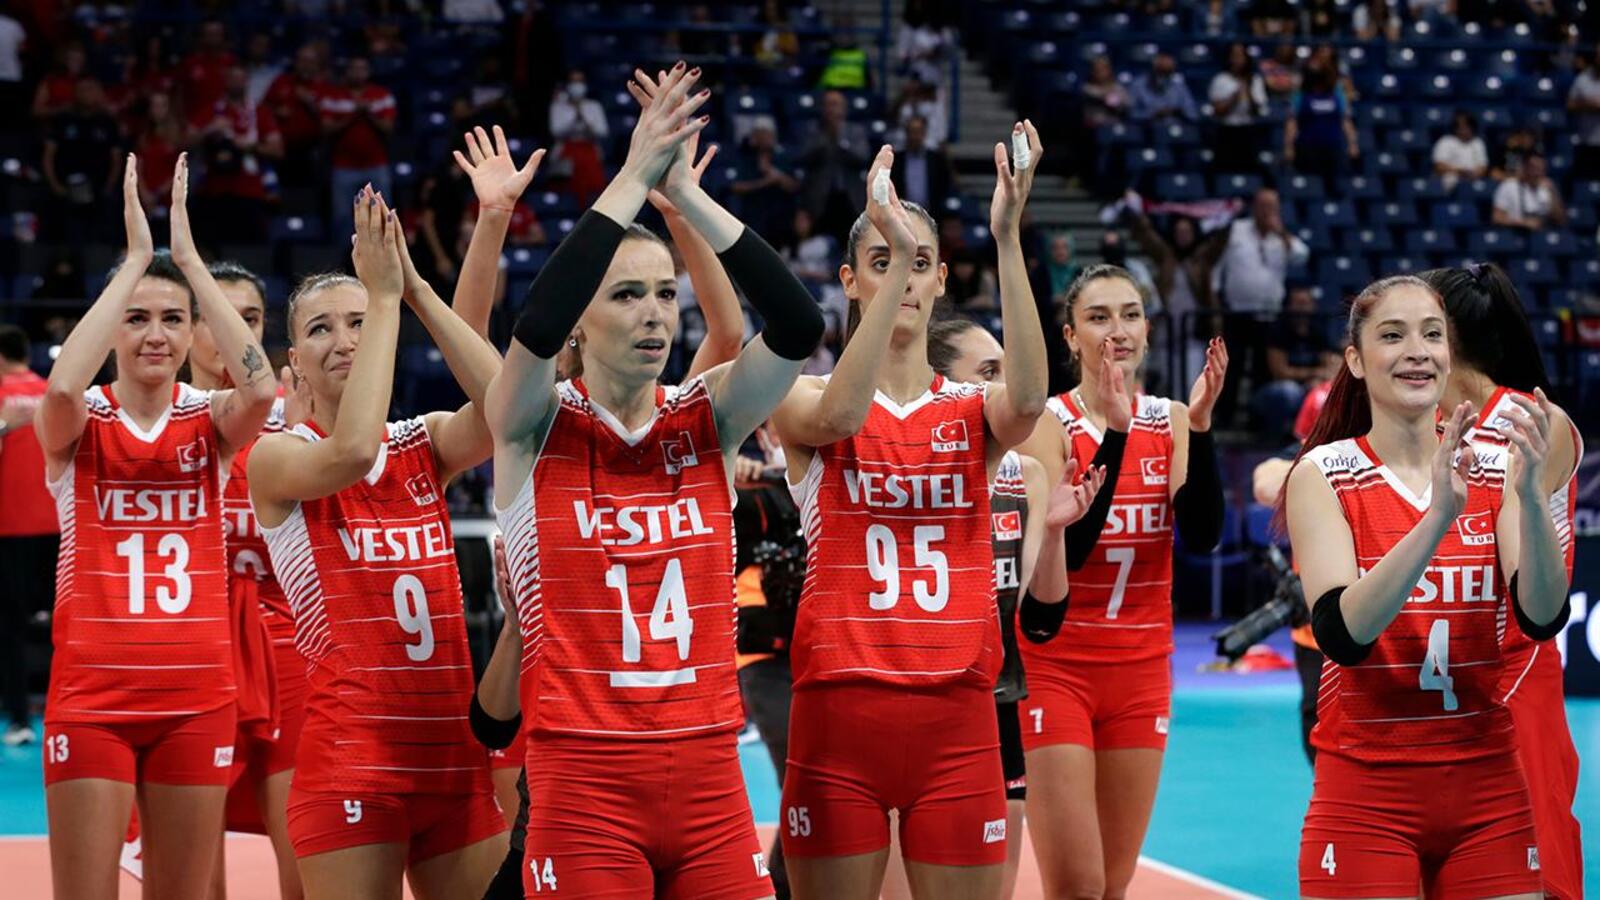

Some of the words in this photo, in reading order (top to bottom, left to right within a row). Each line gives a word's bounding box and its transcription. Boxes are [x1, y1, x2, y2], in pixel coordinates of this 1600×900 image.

[939, 441, 962, 451] TUR
[93, 485, 208, 522] VESTEL
[843, 468, 973, 510] VESTEL
[573, 497, 715, 547] VESTEL
[1101, 502, 1172, 537] STEL
[1470, 534, 1494, 544] TUR
[338, 520, 455, 562] VESTEL
[116, 532, 192, 615] 13
[865, 523, 950, 613] 95
[1105, 546, 1136, 620] 7
[1359, 565, 1497, 604] STEL
[392, 573, 435, 663] 9
[605, 557, 694, 663] 14
[1418, 618, 1459, 712] 4
[1029, 707, 1044, 734] 7
[47, 733, 70, 765] 13
[788, 806, 811, 838] 95
[530, 857, 558, 892] 14
[1321, 842, 1337, 876] 4
